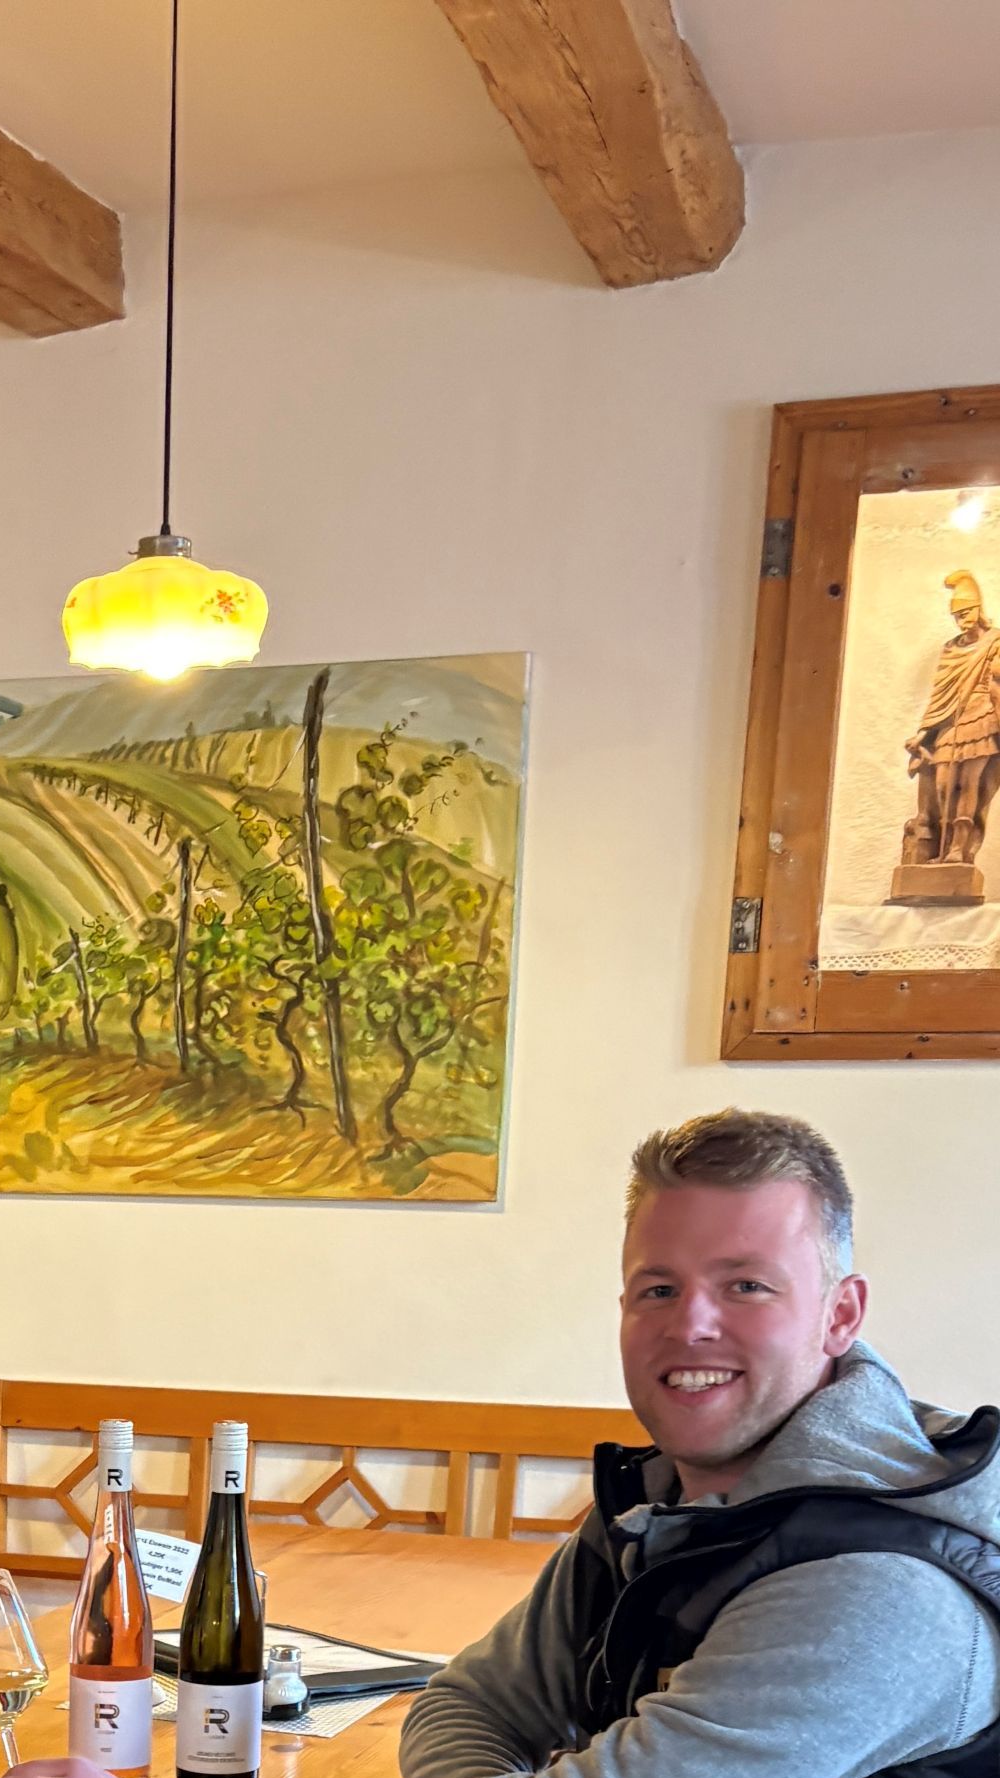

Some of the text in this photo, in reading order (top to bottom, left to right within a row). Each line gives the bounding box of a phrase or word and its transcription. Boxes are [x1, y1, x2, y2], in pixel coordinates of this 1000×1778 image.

[107, 1468, 123, 1486] R
[225, 1471, 240, 1488] R
[94, 1703, 120, 1729] R
[203, 1708, 230, 1734] R
